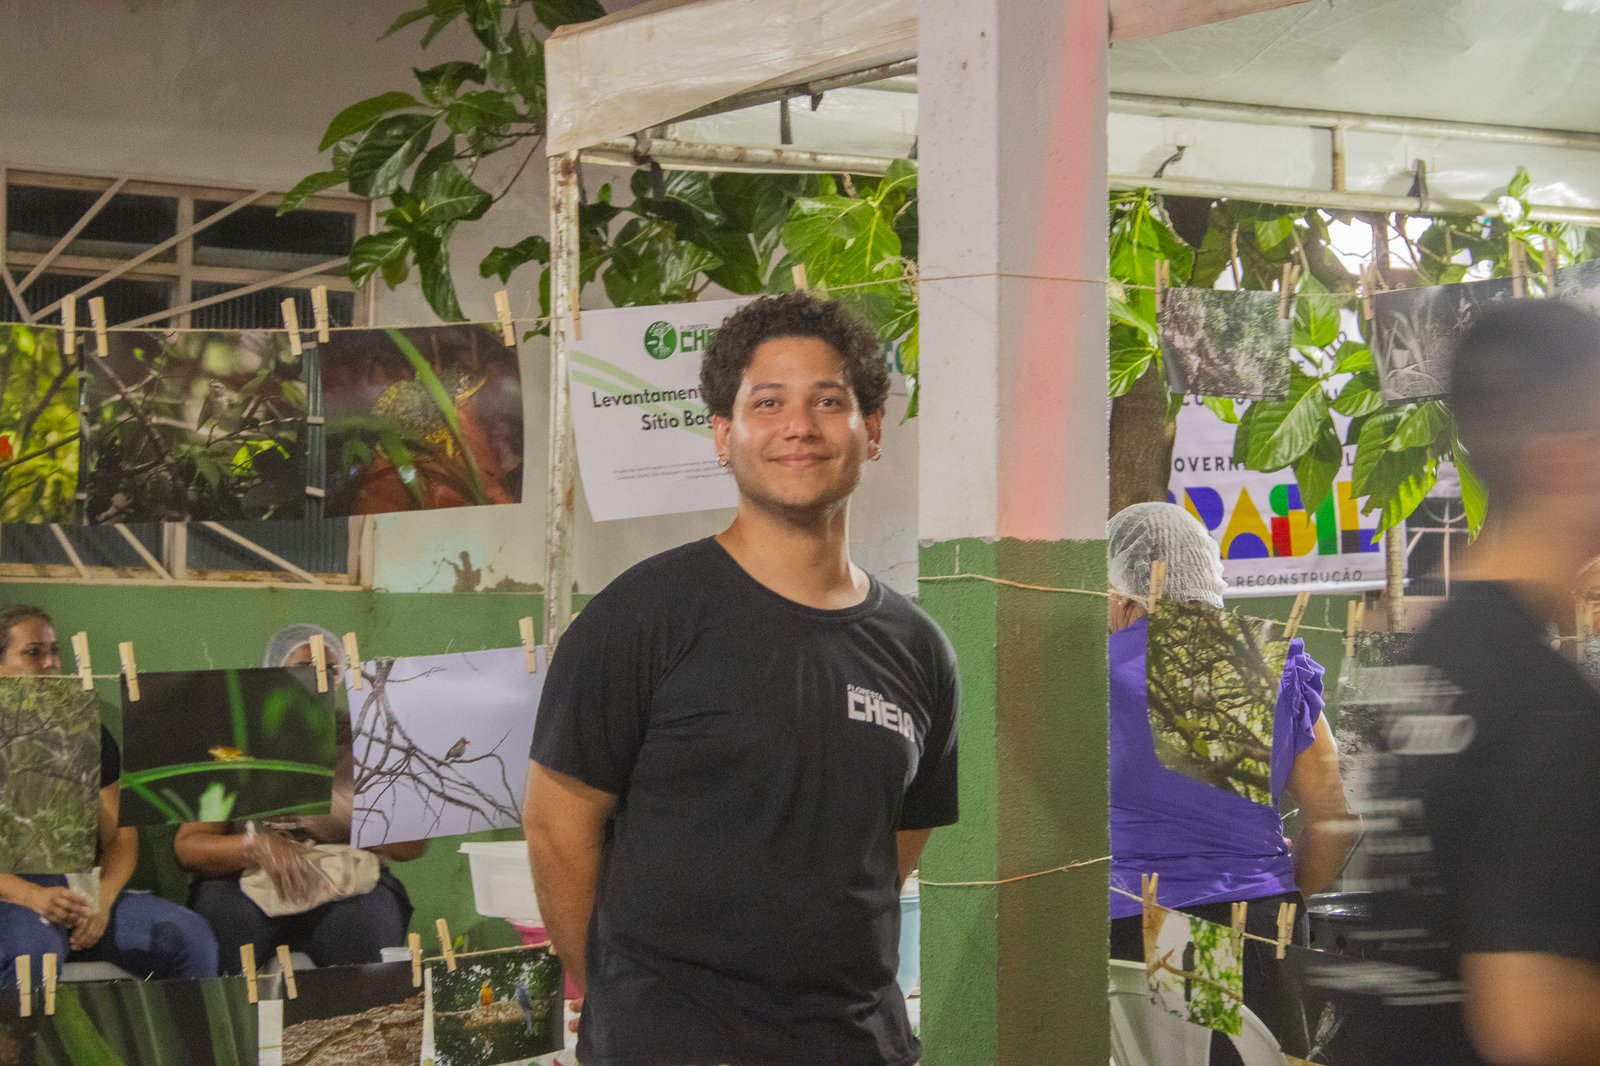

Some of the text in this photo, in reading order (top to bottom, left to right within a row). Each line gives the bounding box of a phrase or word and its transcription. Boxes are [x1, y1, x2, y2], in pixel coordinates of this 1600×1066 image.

[641, 411, 679, 431] Sítio
[1236, 567, 1363, 587] RECONSTRUÇÃO
[847, 691, 916, 743] CHEIA
